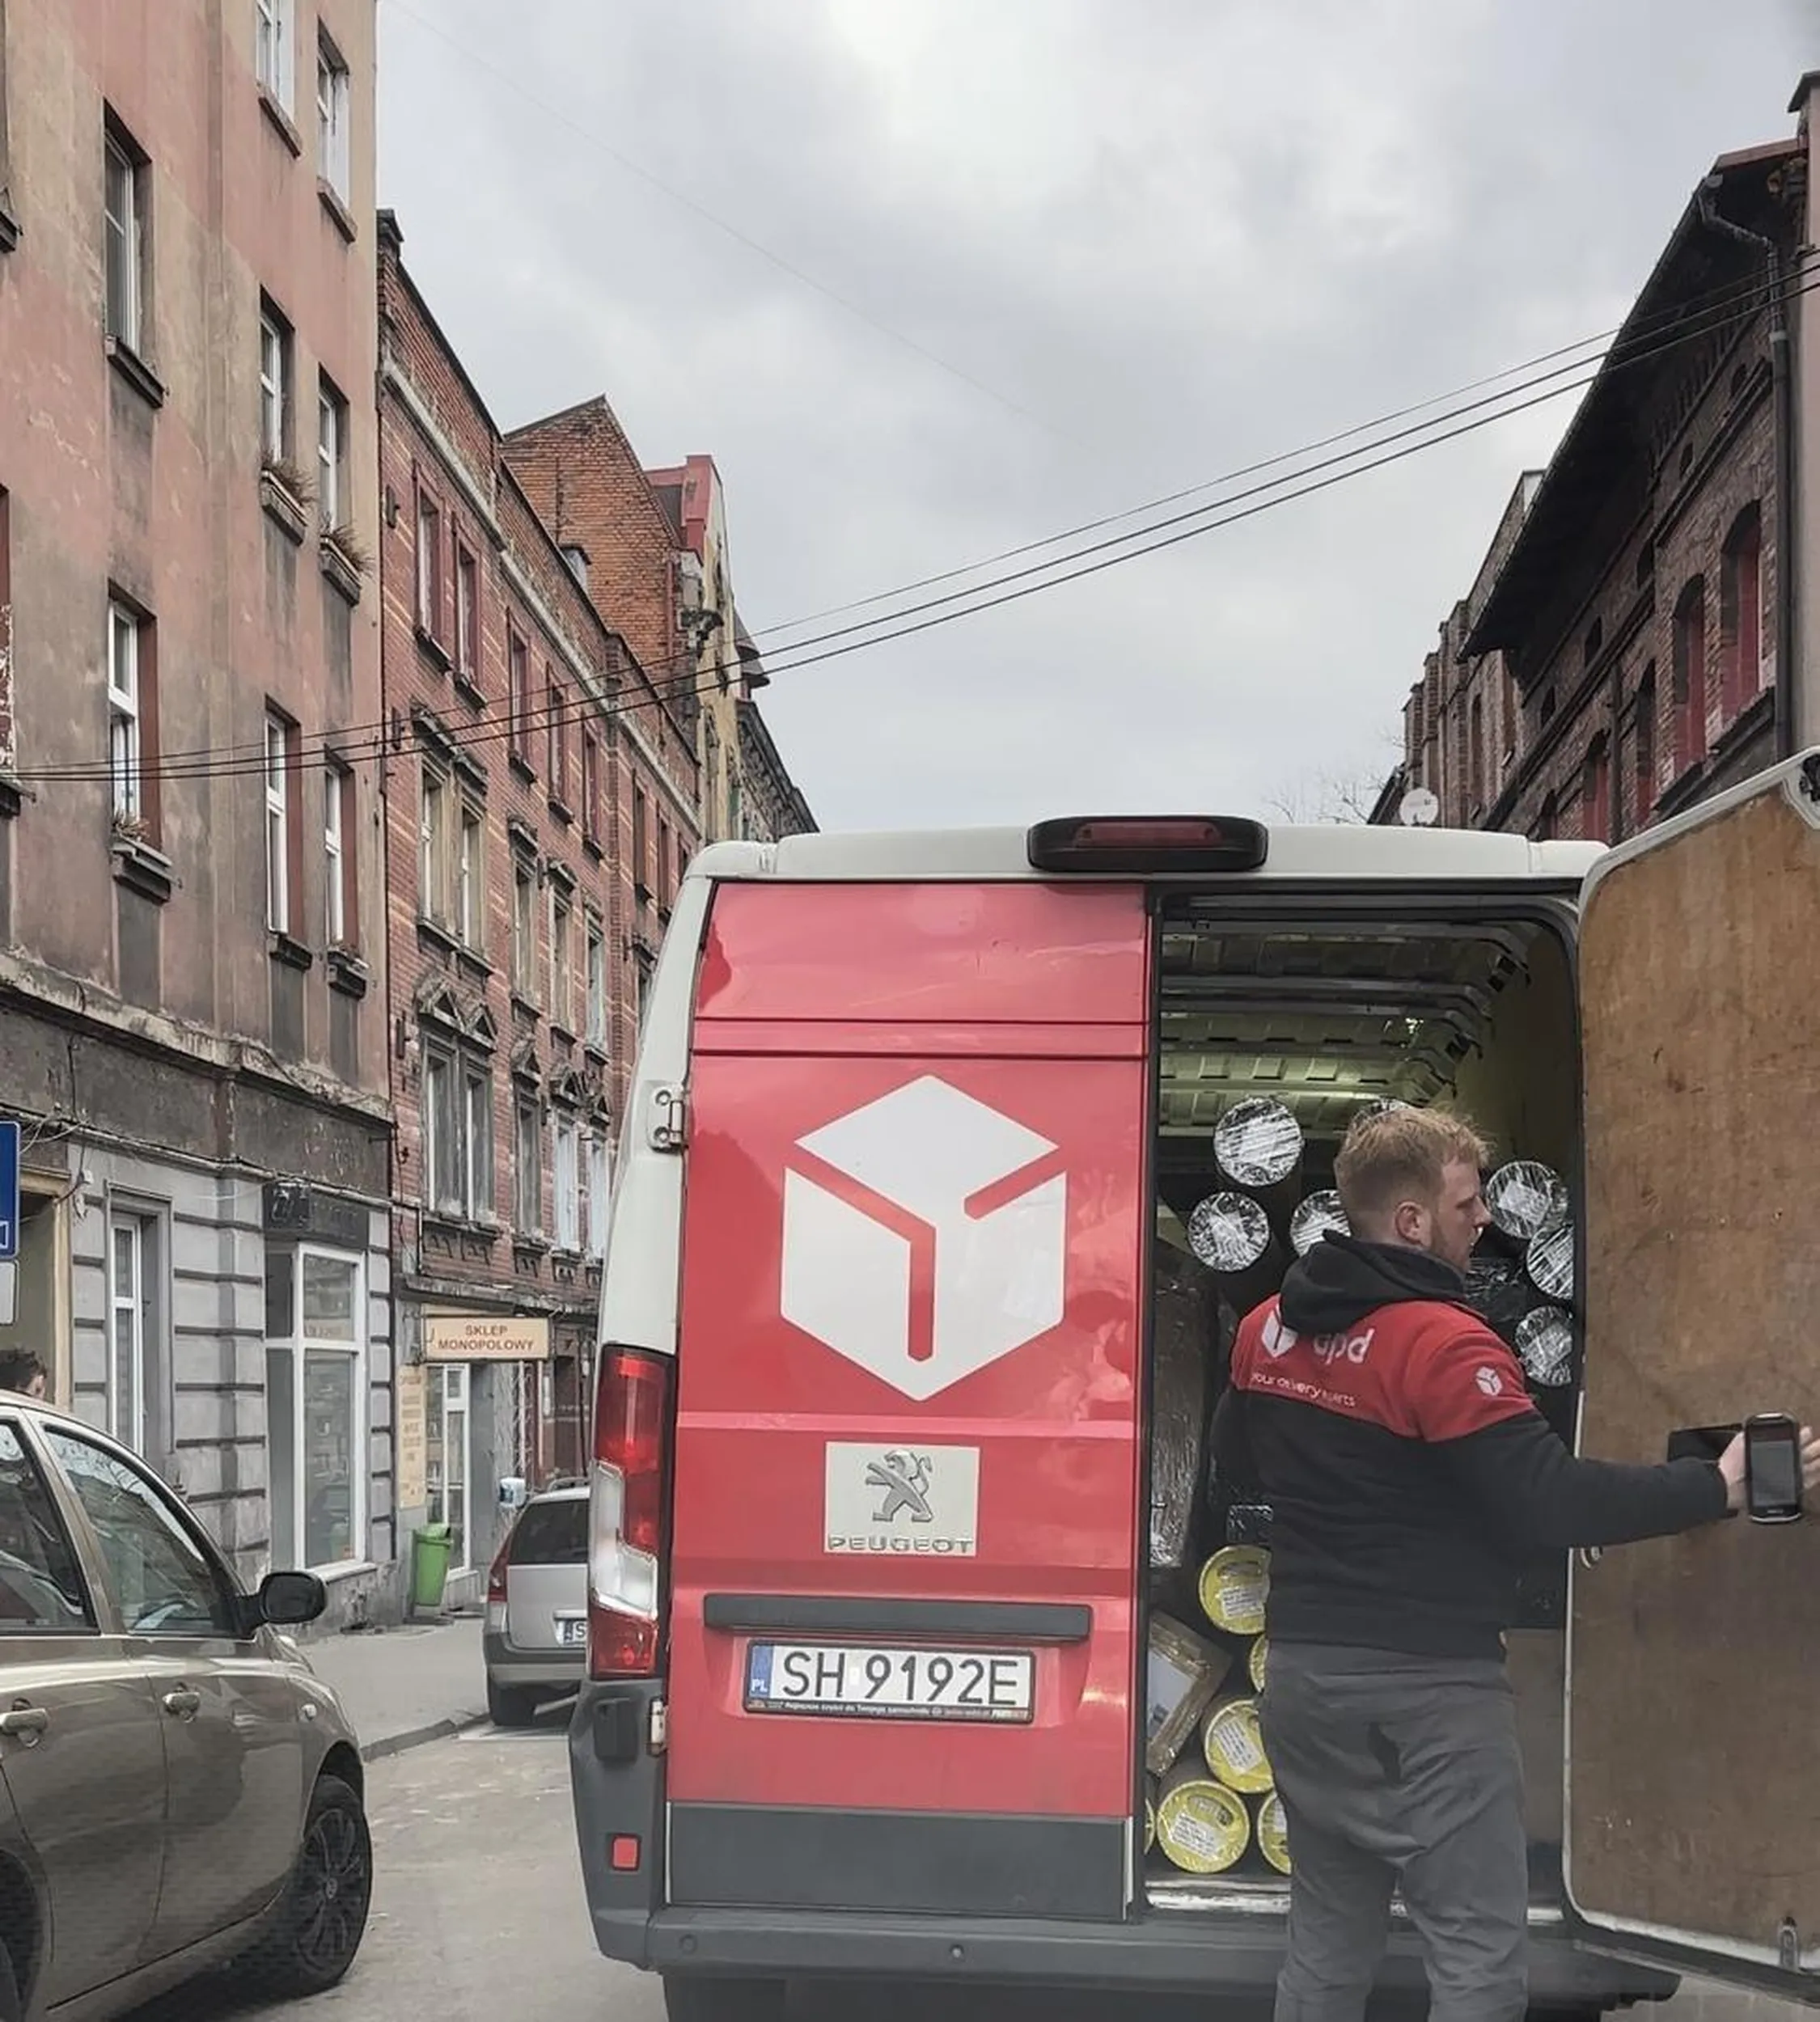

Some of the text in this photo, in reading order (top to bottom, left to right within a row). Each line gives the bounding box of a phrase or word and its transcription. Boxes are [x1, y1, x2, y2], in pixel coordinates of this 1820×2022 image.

[465, 1324, 508, 1335] SKLEP
[438, 1339, 534, 1350] MONOPOLOWY
[827, 1536, 974, 1553] PEUGEOT
[751, 1677, 768, 1693] PL
[782, 1651, 1018, 1706] SH 9192E
